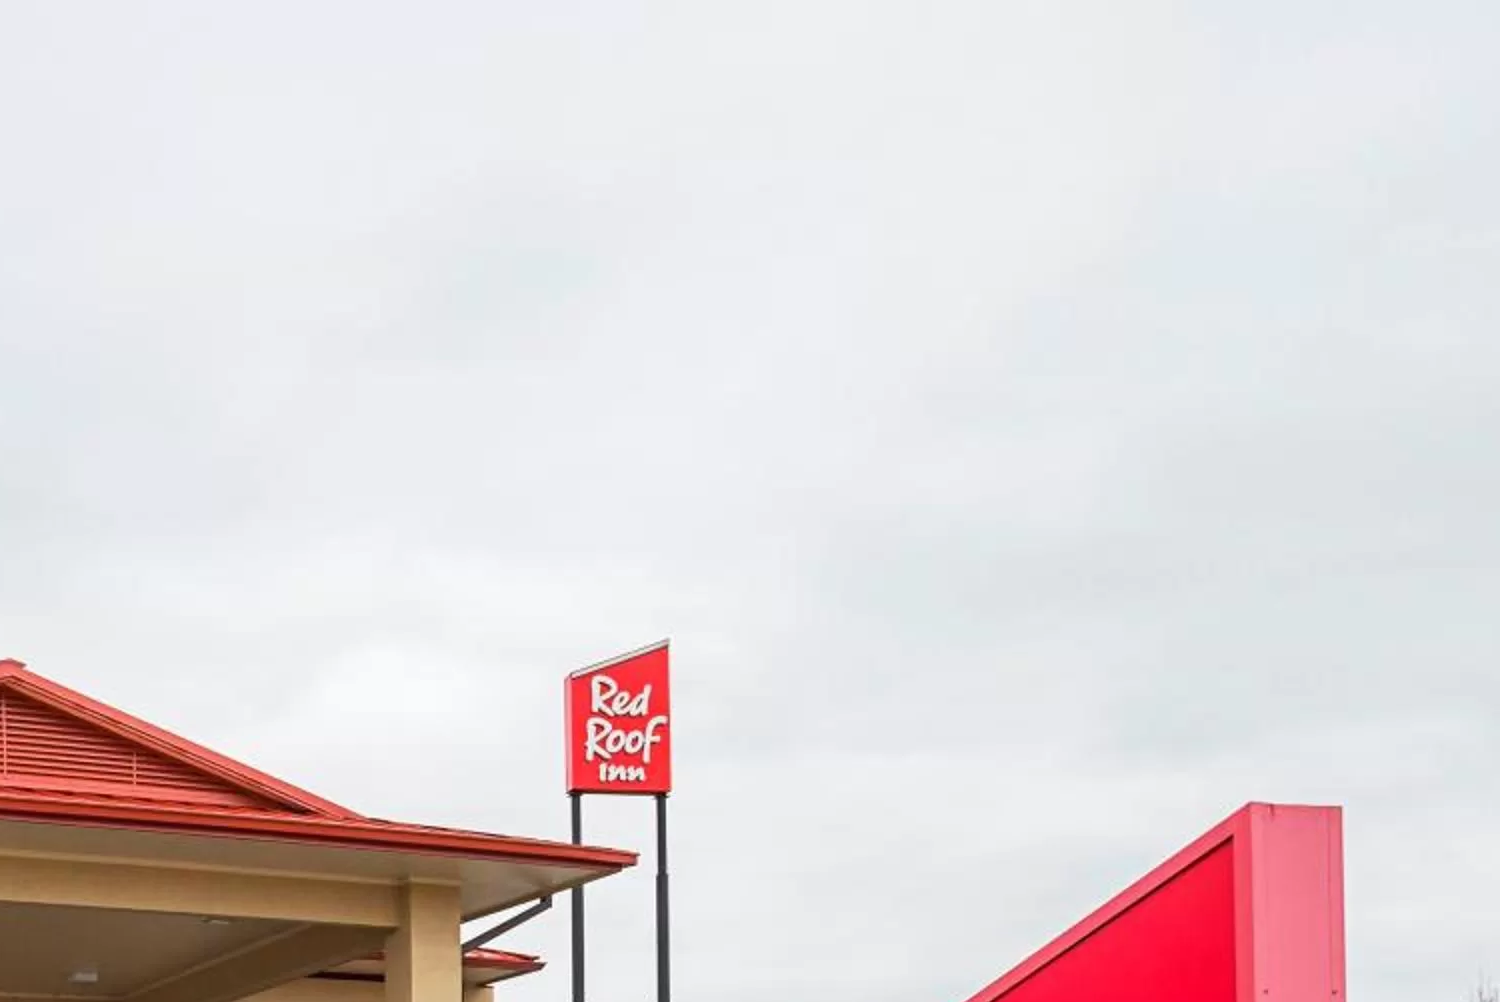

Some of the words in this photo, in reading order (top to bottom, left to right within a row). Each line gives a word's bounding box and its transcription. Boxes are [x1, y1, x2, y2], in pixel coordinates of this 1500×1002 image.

[591, 675, 652, 716] Red
[585, 716, 667, 763] Roof
[599, 764, 646, 782] Inn
